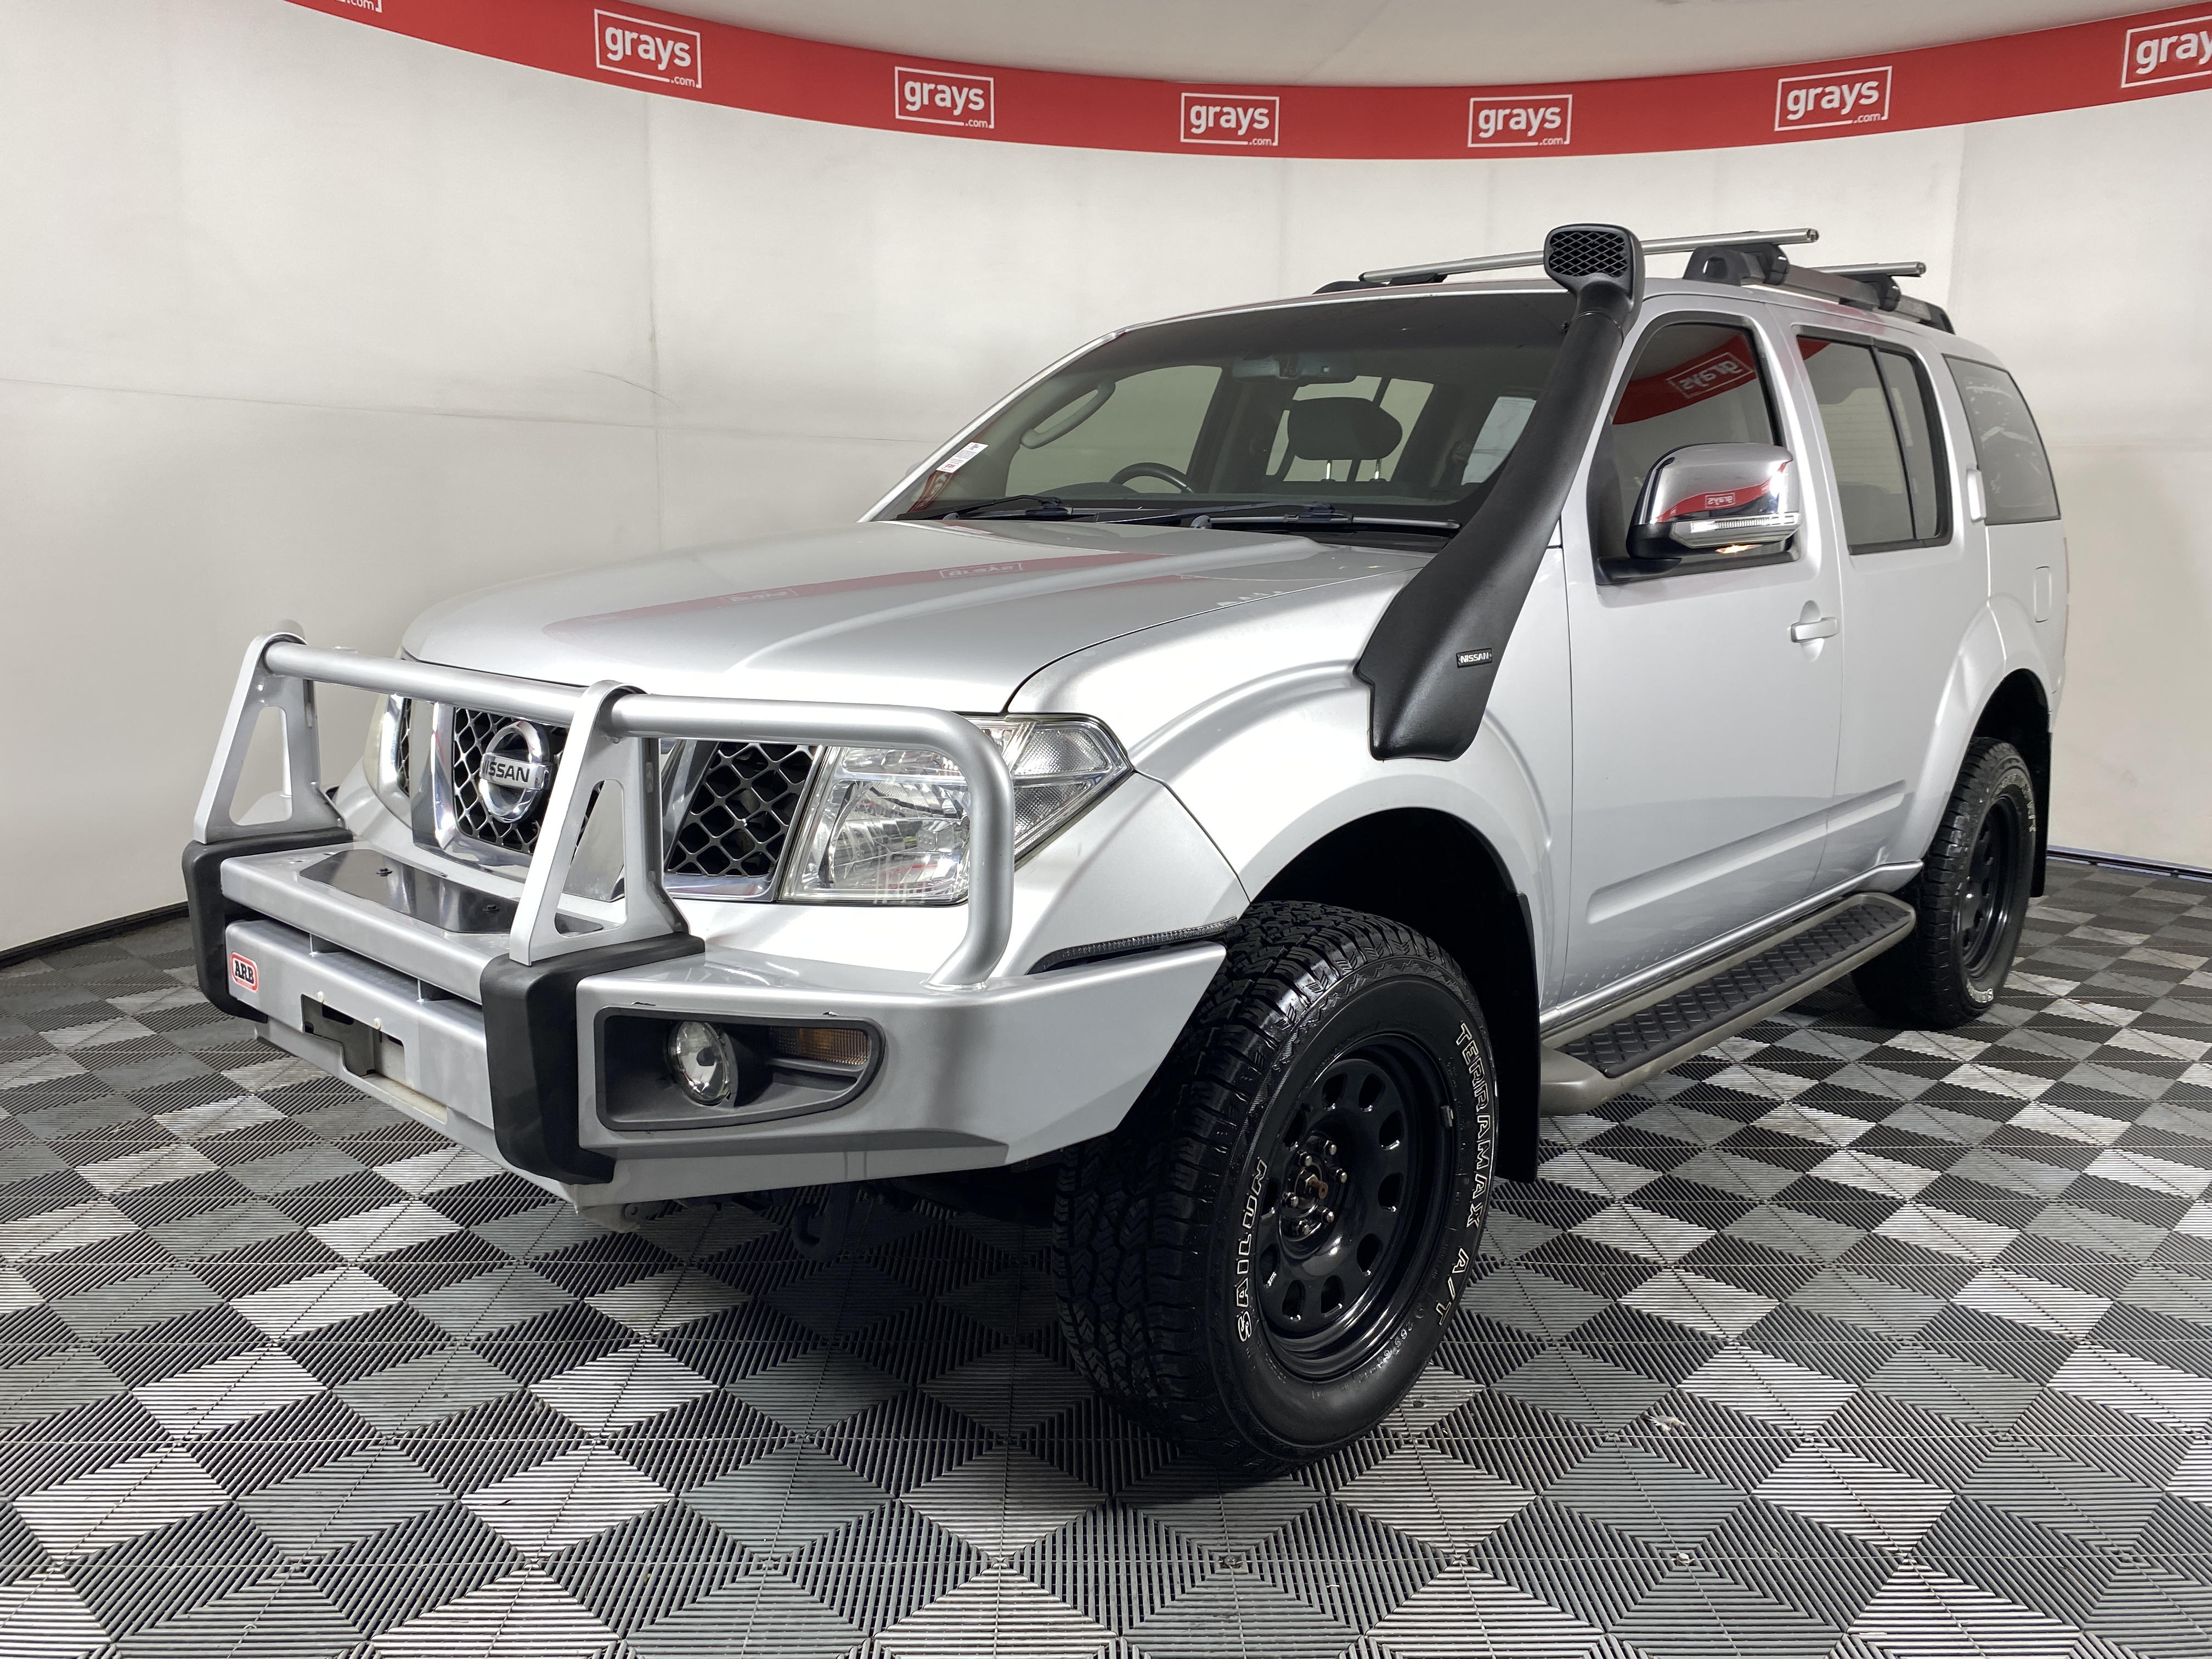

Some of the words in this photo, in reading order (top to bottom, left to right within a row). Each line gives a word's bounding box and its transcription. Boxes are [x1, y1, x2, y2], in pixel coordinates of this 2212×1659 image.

[605, 27, 691, 70] grays
[670, 76, 695, 87] .com
[904, 81, 985, 116] grays
[1786, 81, 1879, 120] grays
[965, 119, 988, 128] .com
[1190, 105, 1269, 136] grays
[1479, 107, 1562, 138] grays
[1853, 113, 1881, 123] .com
[1539, 137, 1563, 145] .com
[1460, 652, 1489, 663] NISSAN
[483, 760, 531, 782] NISSAN
[235, 960, 254, 984] ARB
[1456, 1022, 1491, 1228] TERRAMAX
[1237, 1159, 1267, 1342] SAILUN
[1435, 1248, 1469, 1325] A/T
